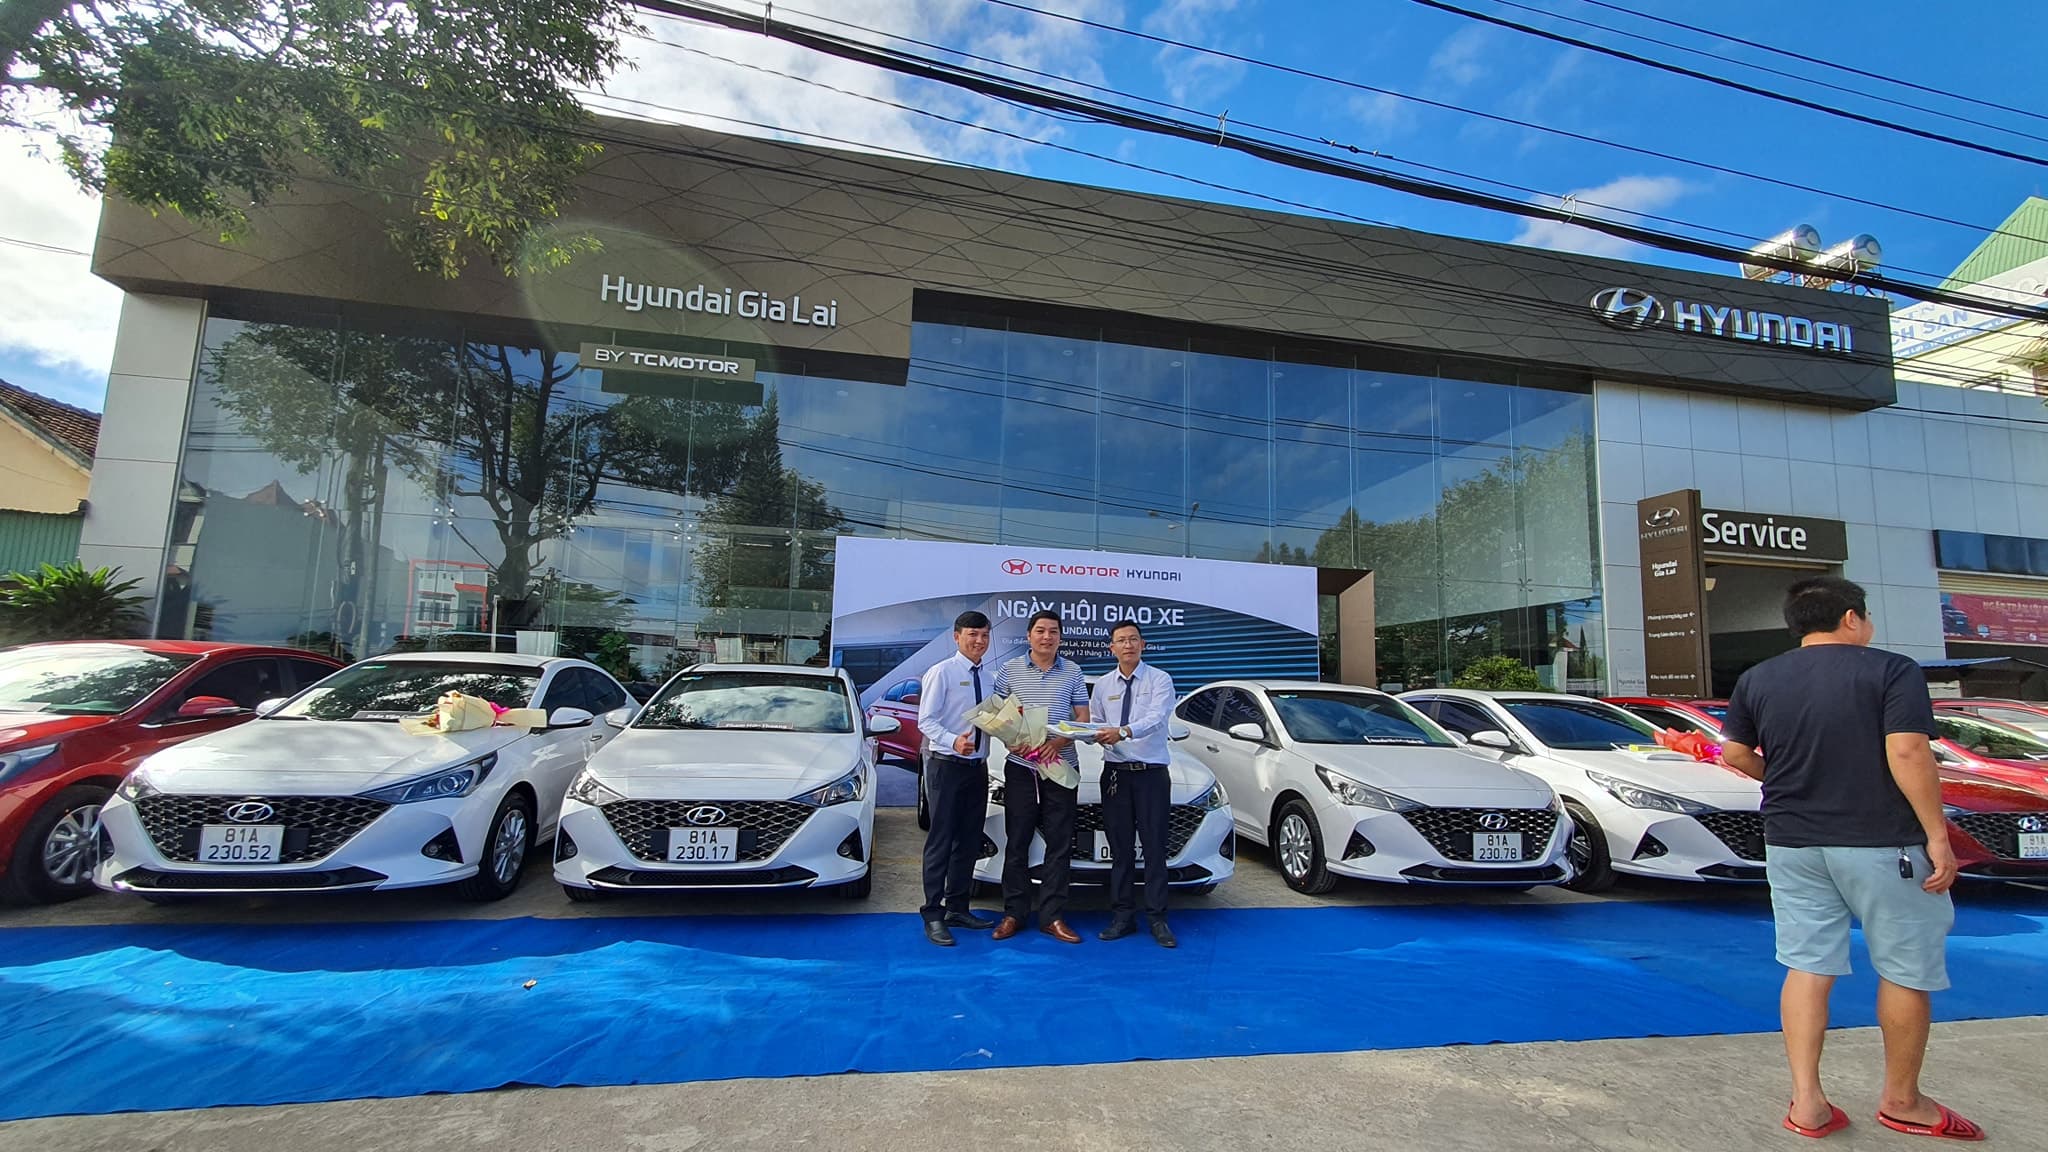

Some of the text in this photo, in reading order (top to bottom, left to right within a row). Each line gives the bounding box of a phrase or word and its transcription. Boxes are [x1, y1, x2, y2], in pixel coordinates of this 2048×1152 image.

[601, 274, 838, 327] Hyundai Gia Lai
[1673, 300, 1854, 353] HYUNDAI
[595, 348, 739, 375] BY TCMOTOR
[1640, 525, 1688, 539] HYUNDAI
[1702, 512, 1807, 550] Service
[1036, 563, 1181, 582] TC MOTOR HYUNDAI
[1651, 560, 1678, 571] Hyundai
[997, 596, 1185, 626] NGÀY HỘI GIAO XE
[1062, 626, 1109, 636] UNDAI GIA
[225, 828, 258, 843] 81A
[689, 830, 718, 844] 81A
[1487, 835, 1509, 846] 81A
[208, 845, 271, 860] 230.52
[676, 846, 729, 860] 230.17
[1479, 848, 1517, 860] 230.78
